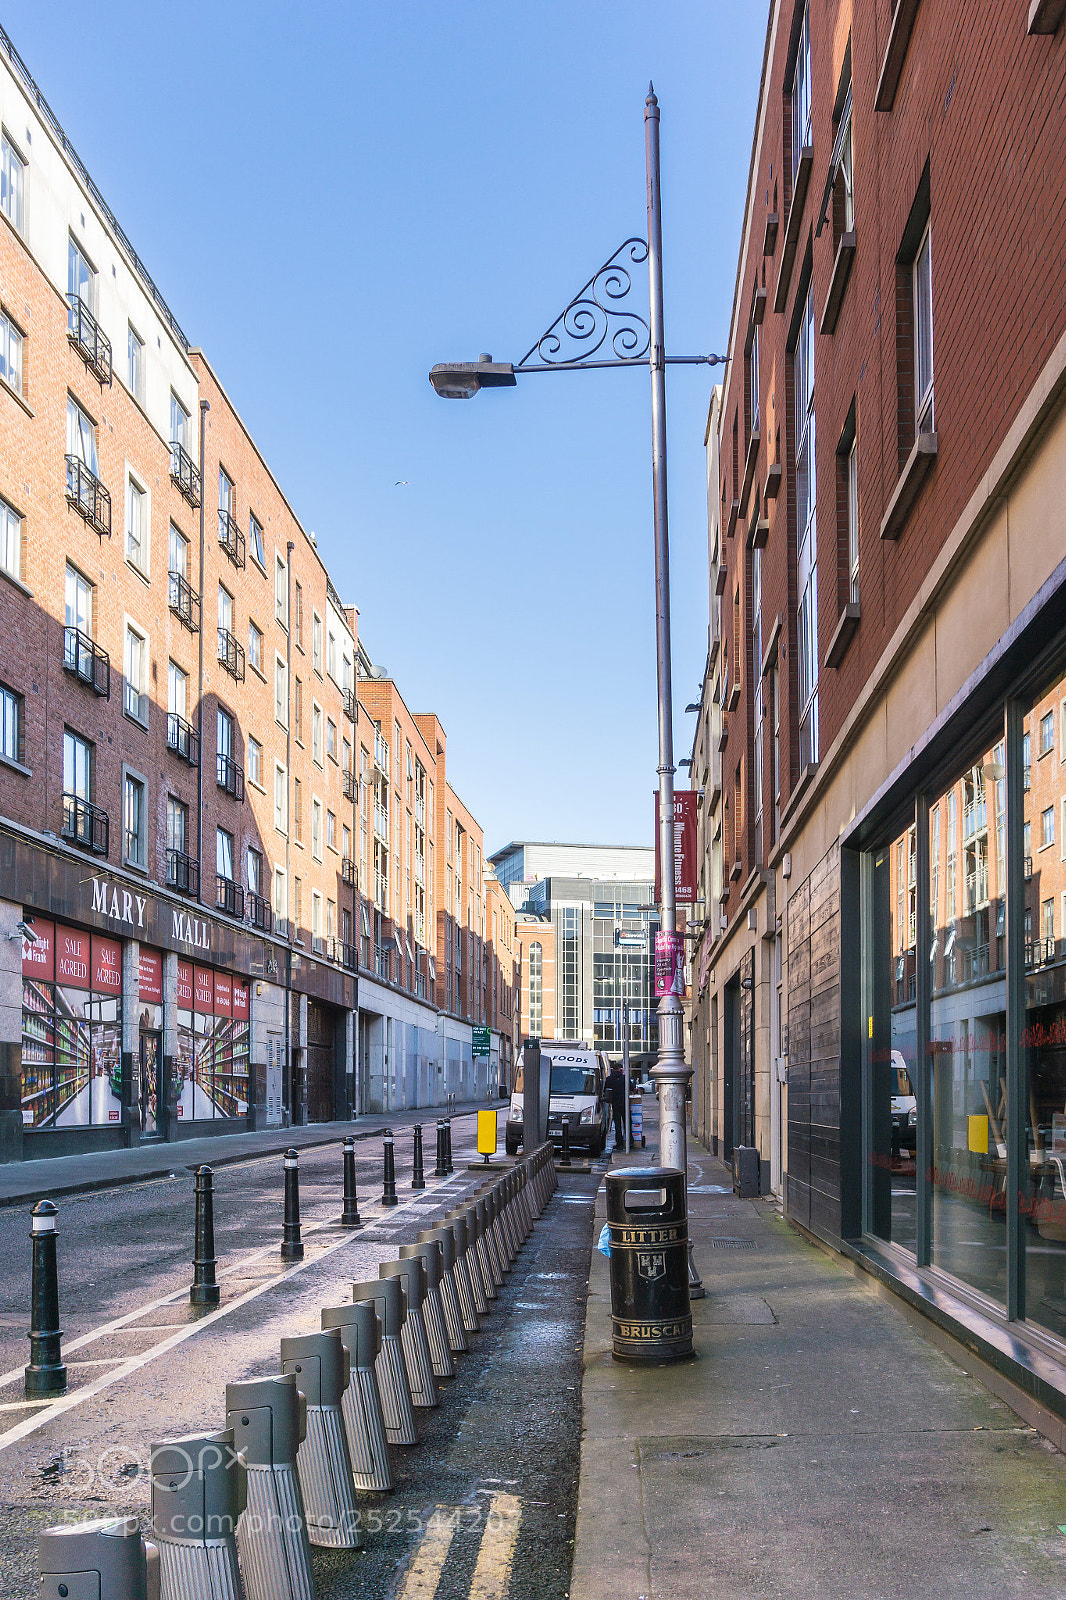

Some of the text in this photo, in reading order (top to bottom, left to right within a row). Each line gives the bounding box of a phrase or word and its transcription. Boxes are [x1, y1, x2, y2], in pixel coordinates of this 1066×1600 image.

[674, 822, 686, 853] Minute
[674, 854, 686, 885] Fitness
[90, 878, 210, 950] MARY MALL
[64, 937, 82, 957] SALE
[33, 950, 47, 964] Frank
[101, 948, 116, 966] SALE
[59, 958, 87, 979] AGREED
[95, 967, 121, 986] AGREED
[198, 973, 209, 987] SALE
[195, 989, 212, 1004] AGREED
[552, 1055, 589, 1064] FOODS
[621, 1229, 678, 1243] LITTER
